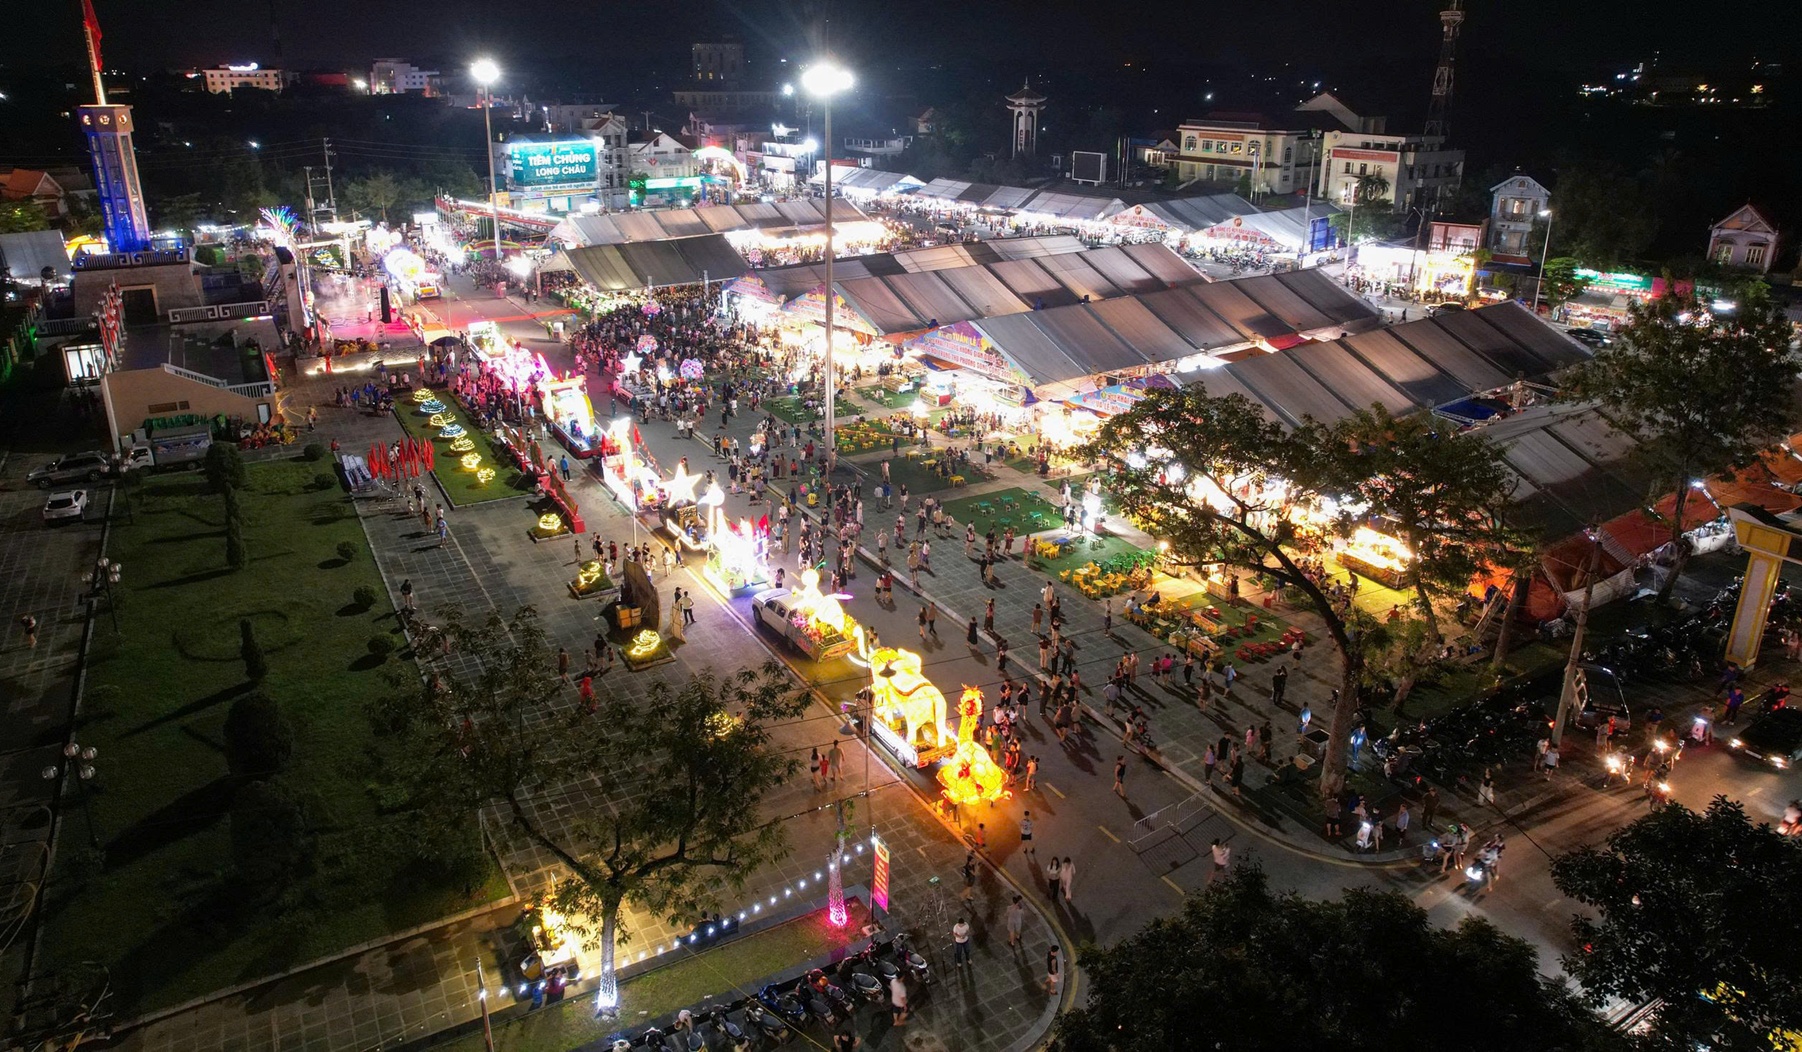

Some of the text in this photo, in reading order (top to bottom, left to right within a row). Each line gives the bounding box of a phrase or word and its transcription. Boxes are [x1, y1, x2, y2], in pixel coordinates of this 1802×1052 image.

[553, 150, 591, 165] CHỦNG
[535, 164, 587, 177] LONG CHÂU
